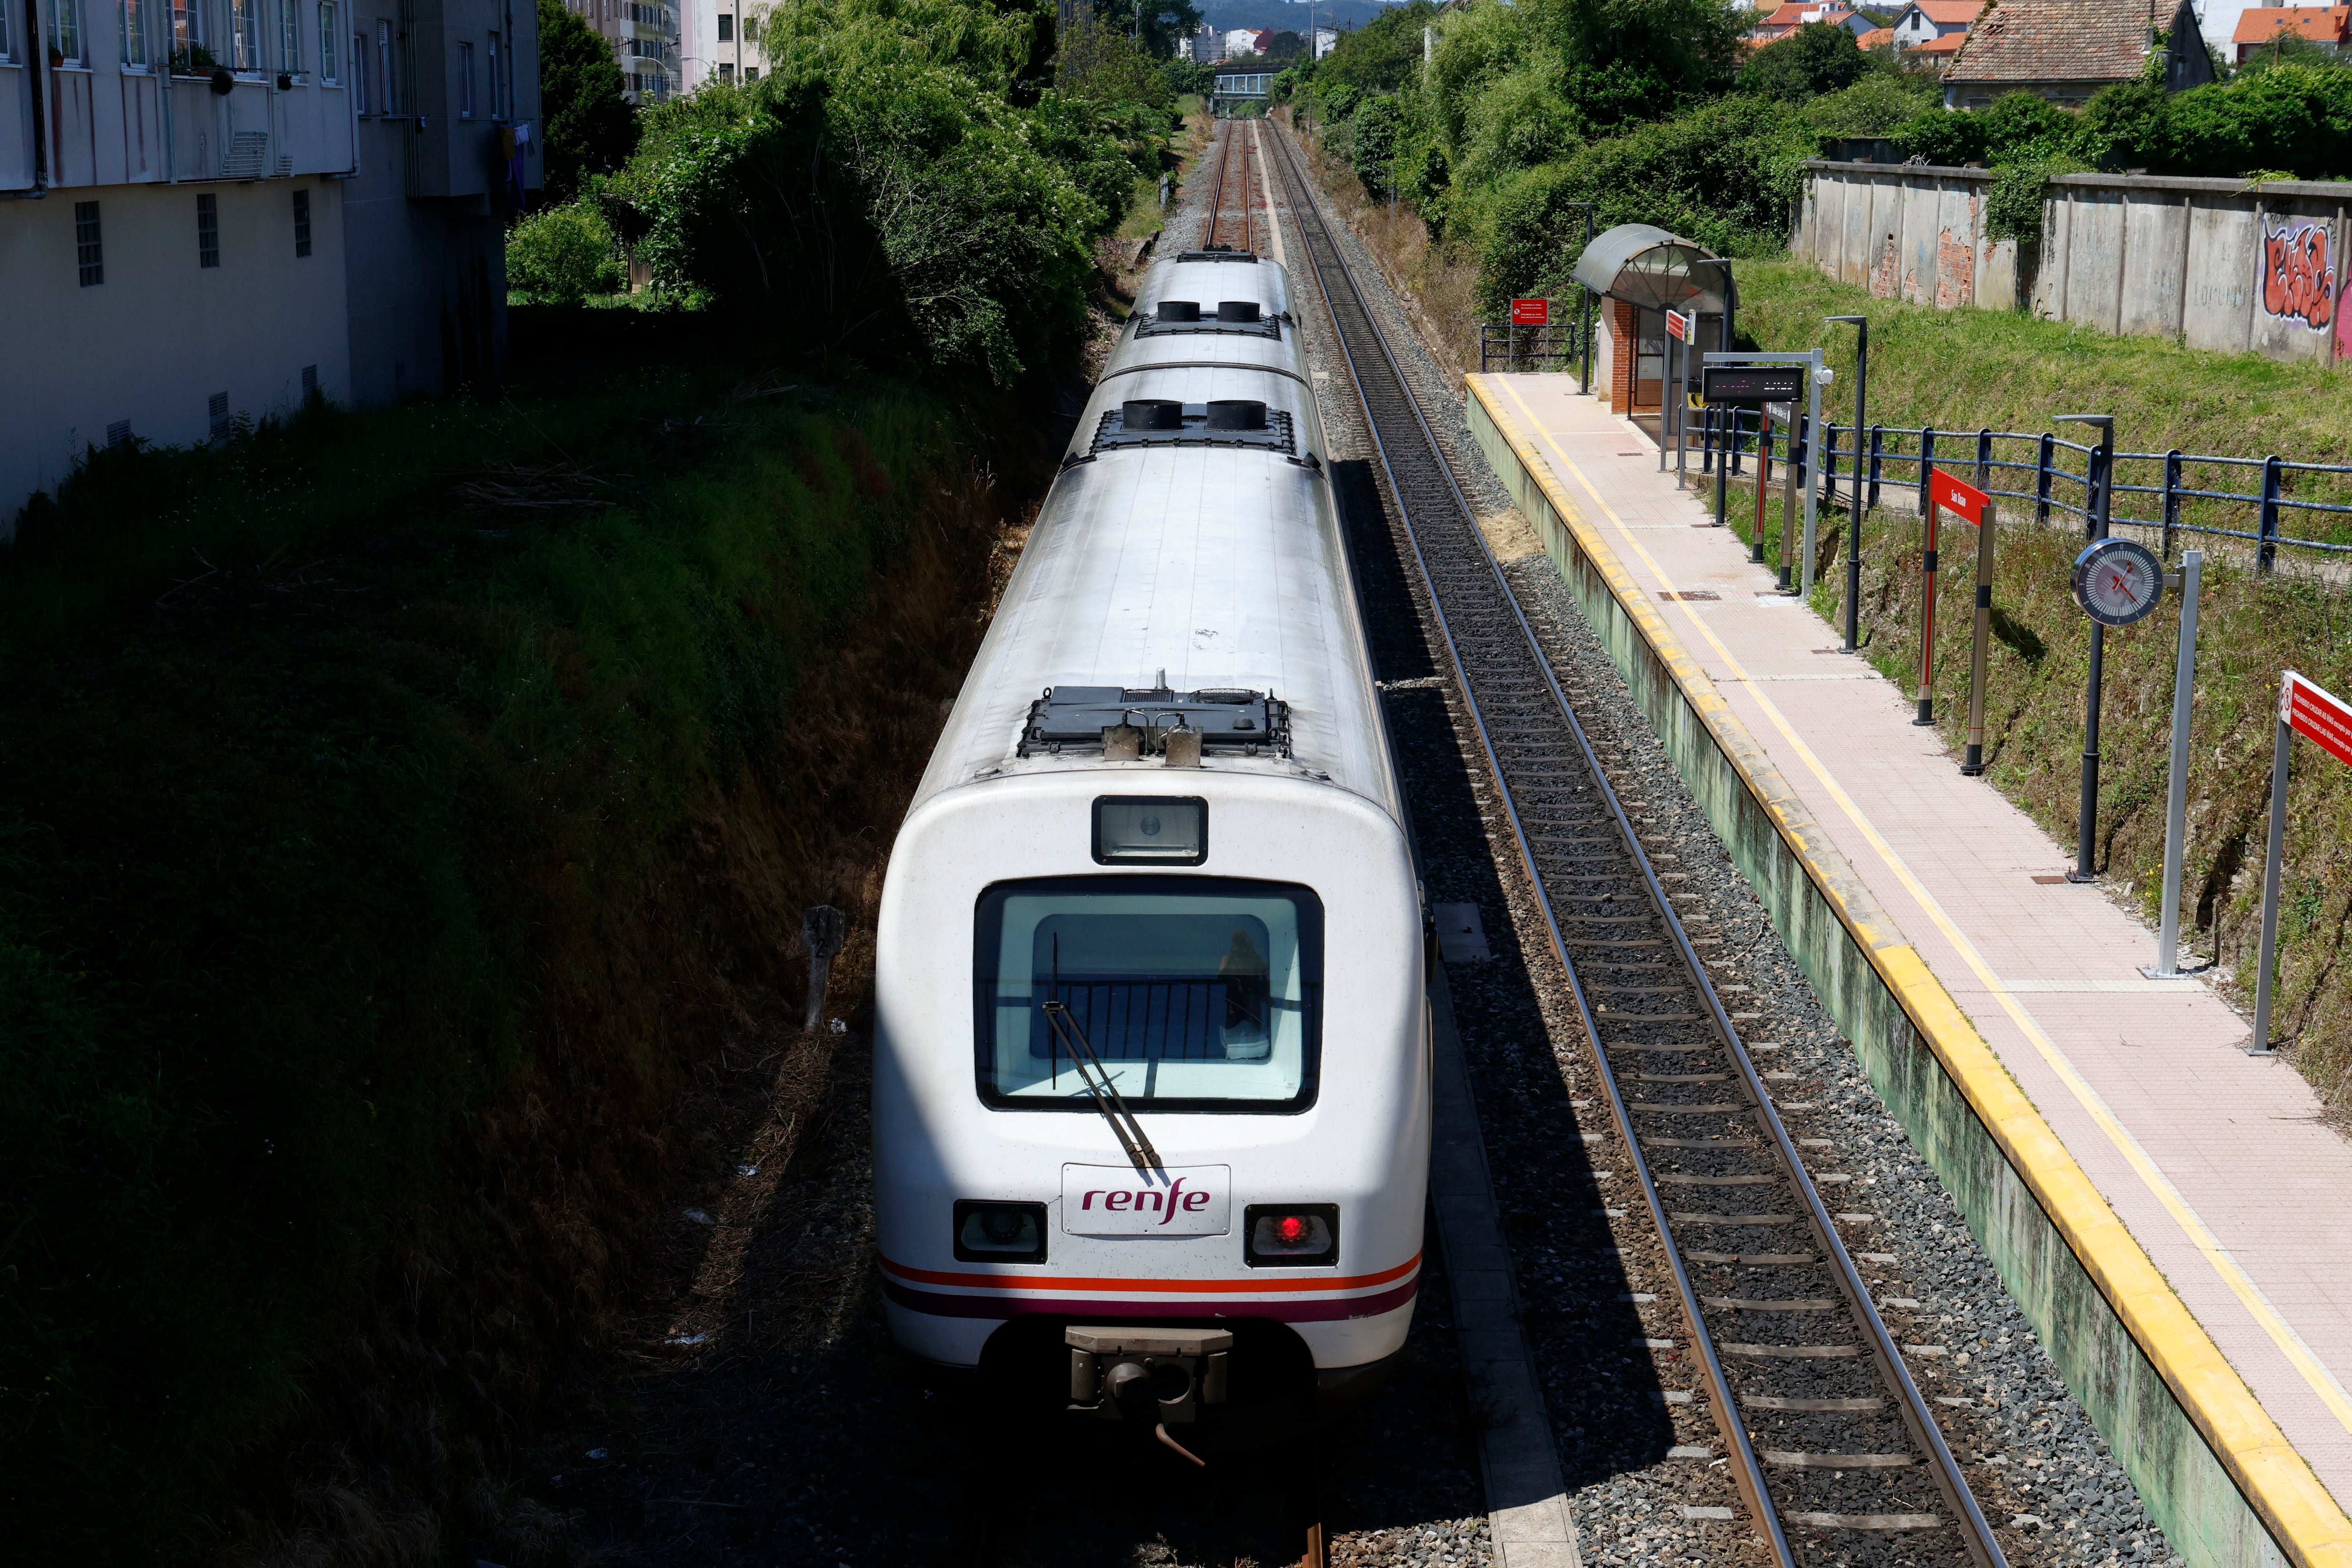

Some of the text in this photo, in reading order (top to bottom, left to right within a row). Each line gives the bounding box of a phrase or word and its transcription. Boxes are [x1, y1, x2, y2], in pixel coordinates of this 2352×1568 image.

[1957, 492, 1966, 507] Xoan
[2292, 707, 2308, 723] PROHIBIDO
[2308, 718, 2320, 732] CRUZAR
[2333, 737, 2345, 749] excepto
[2294, 693, 2310, 709] PROHIBIDO
[2310, 703, 2322, 717] CRUZAR
[2321, 711, 2327, 720] AS
[2334, 721, 2345, 732] excepto
[1082, 1177, 1210, 1225] renfe
